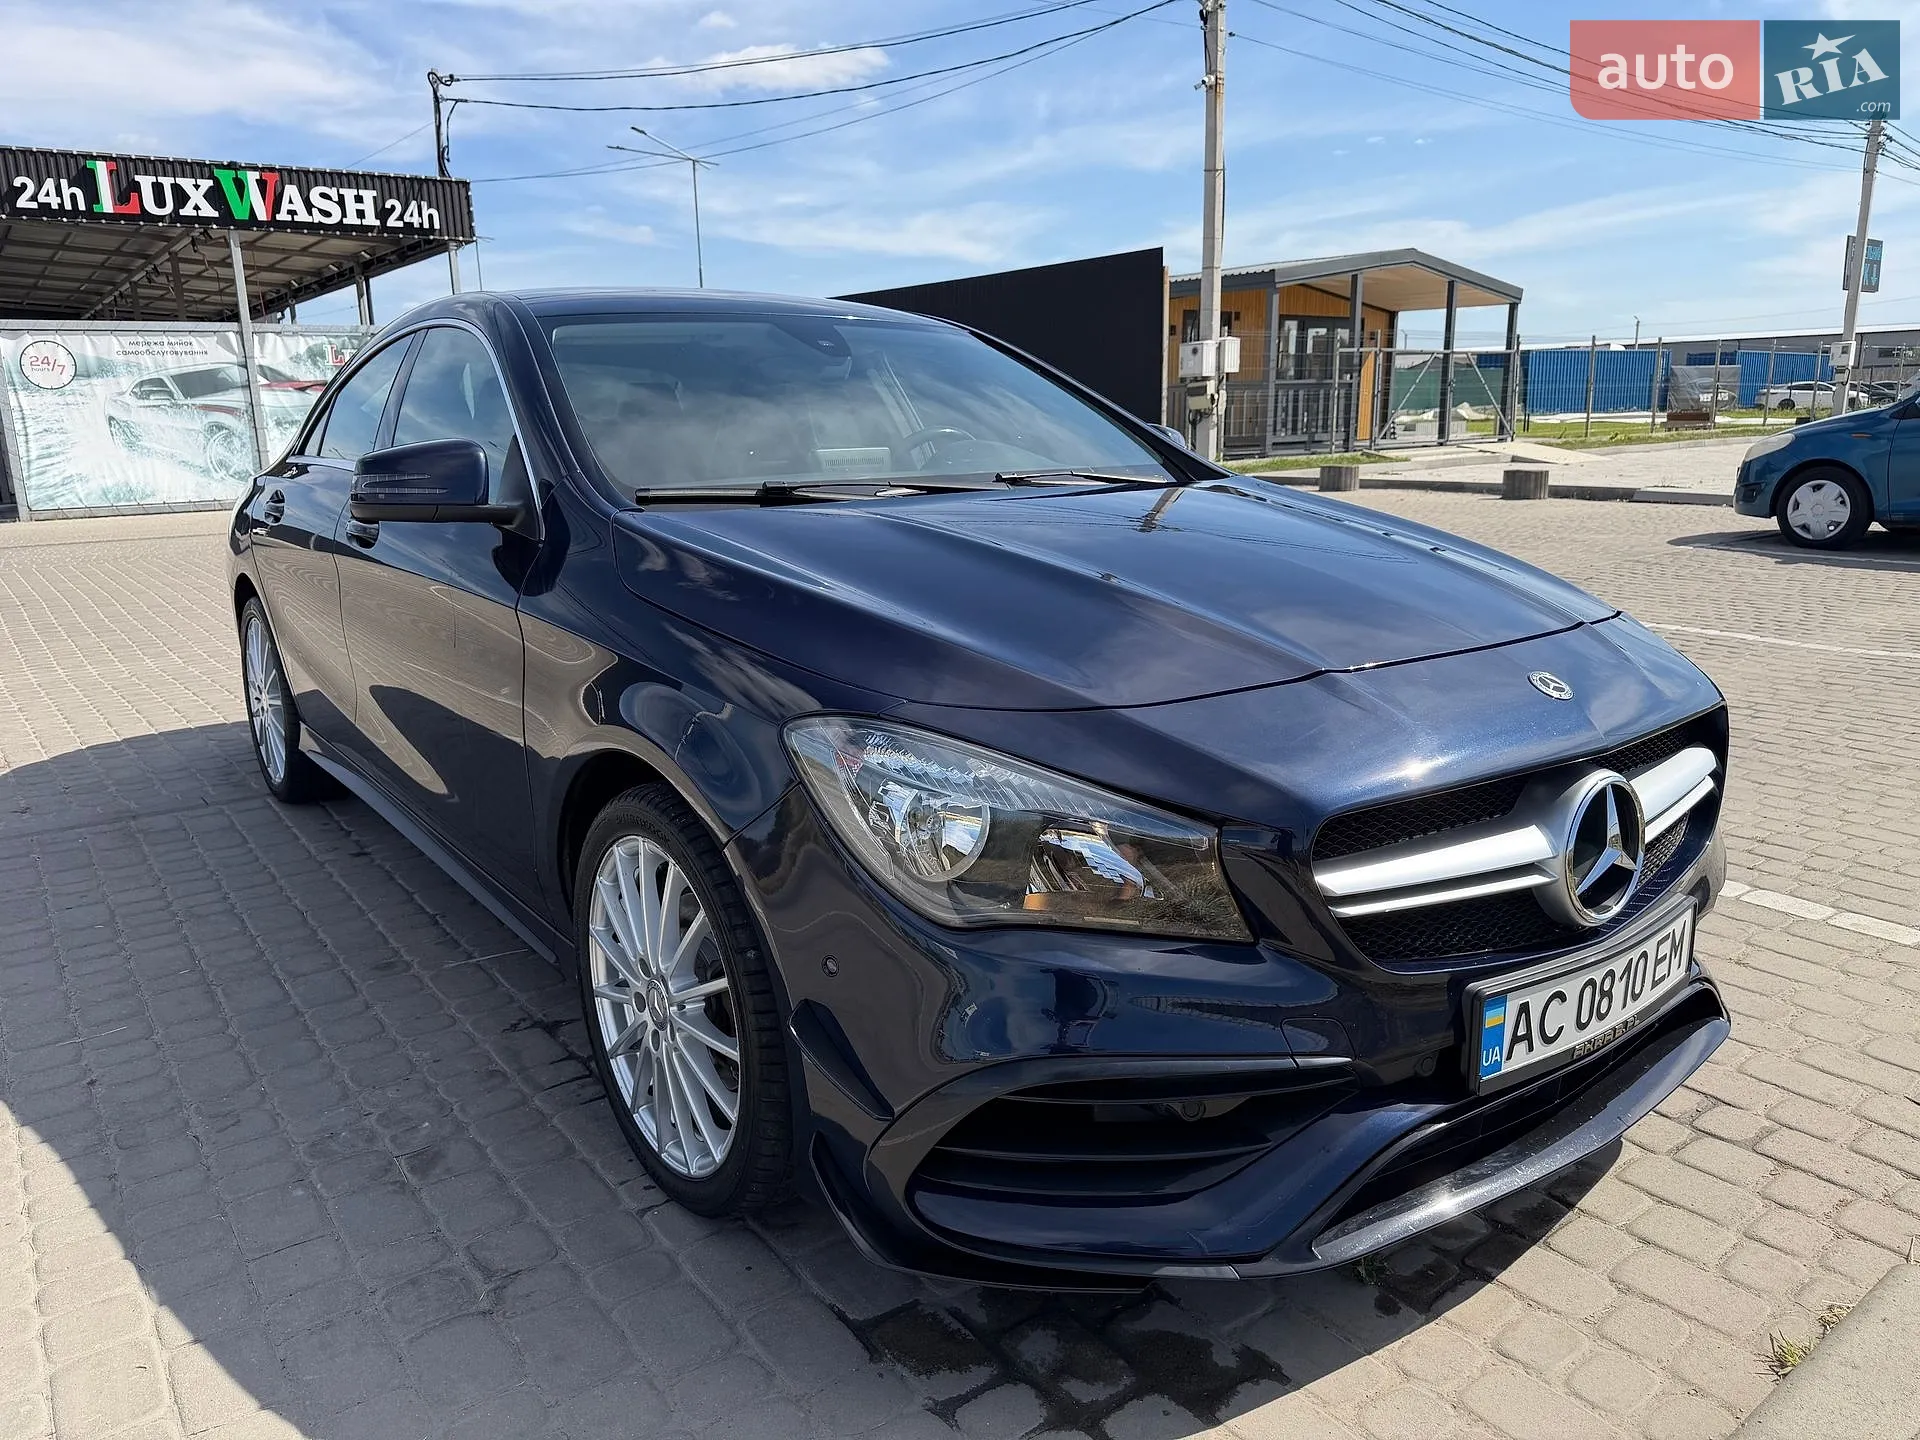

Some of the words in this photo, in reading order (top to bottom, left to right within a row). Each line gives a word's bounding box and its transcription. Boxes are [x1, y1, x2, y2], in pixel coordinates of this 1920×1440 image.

[12, 175, 87, 212] 24h
[384, 198, 441, 231] 24h
[115, 348, 209, 357] самообслуговування
[128, 340, 165, 348] мережа
[28, 355, 67, 376] 24/7
[1505, 989, 1568, 1061] AC
[1575, 949, 1649, 1031] 0810
[1650, 919, 1687, 992] EM
[1482, 1046, 1501, 1066] UA
